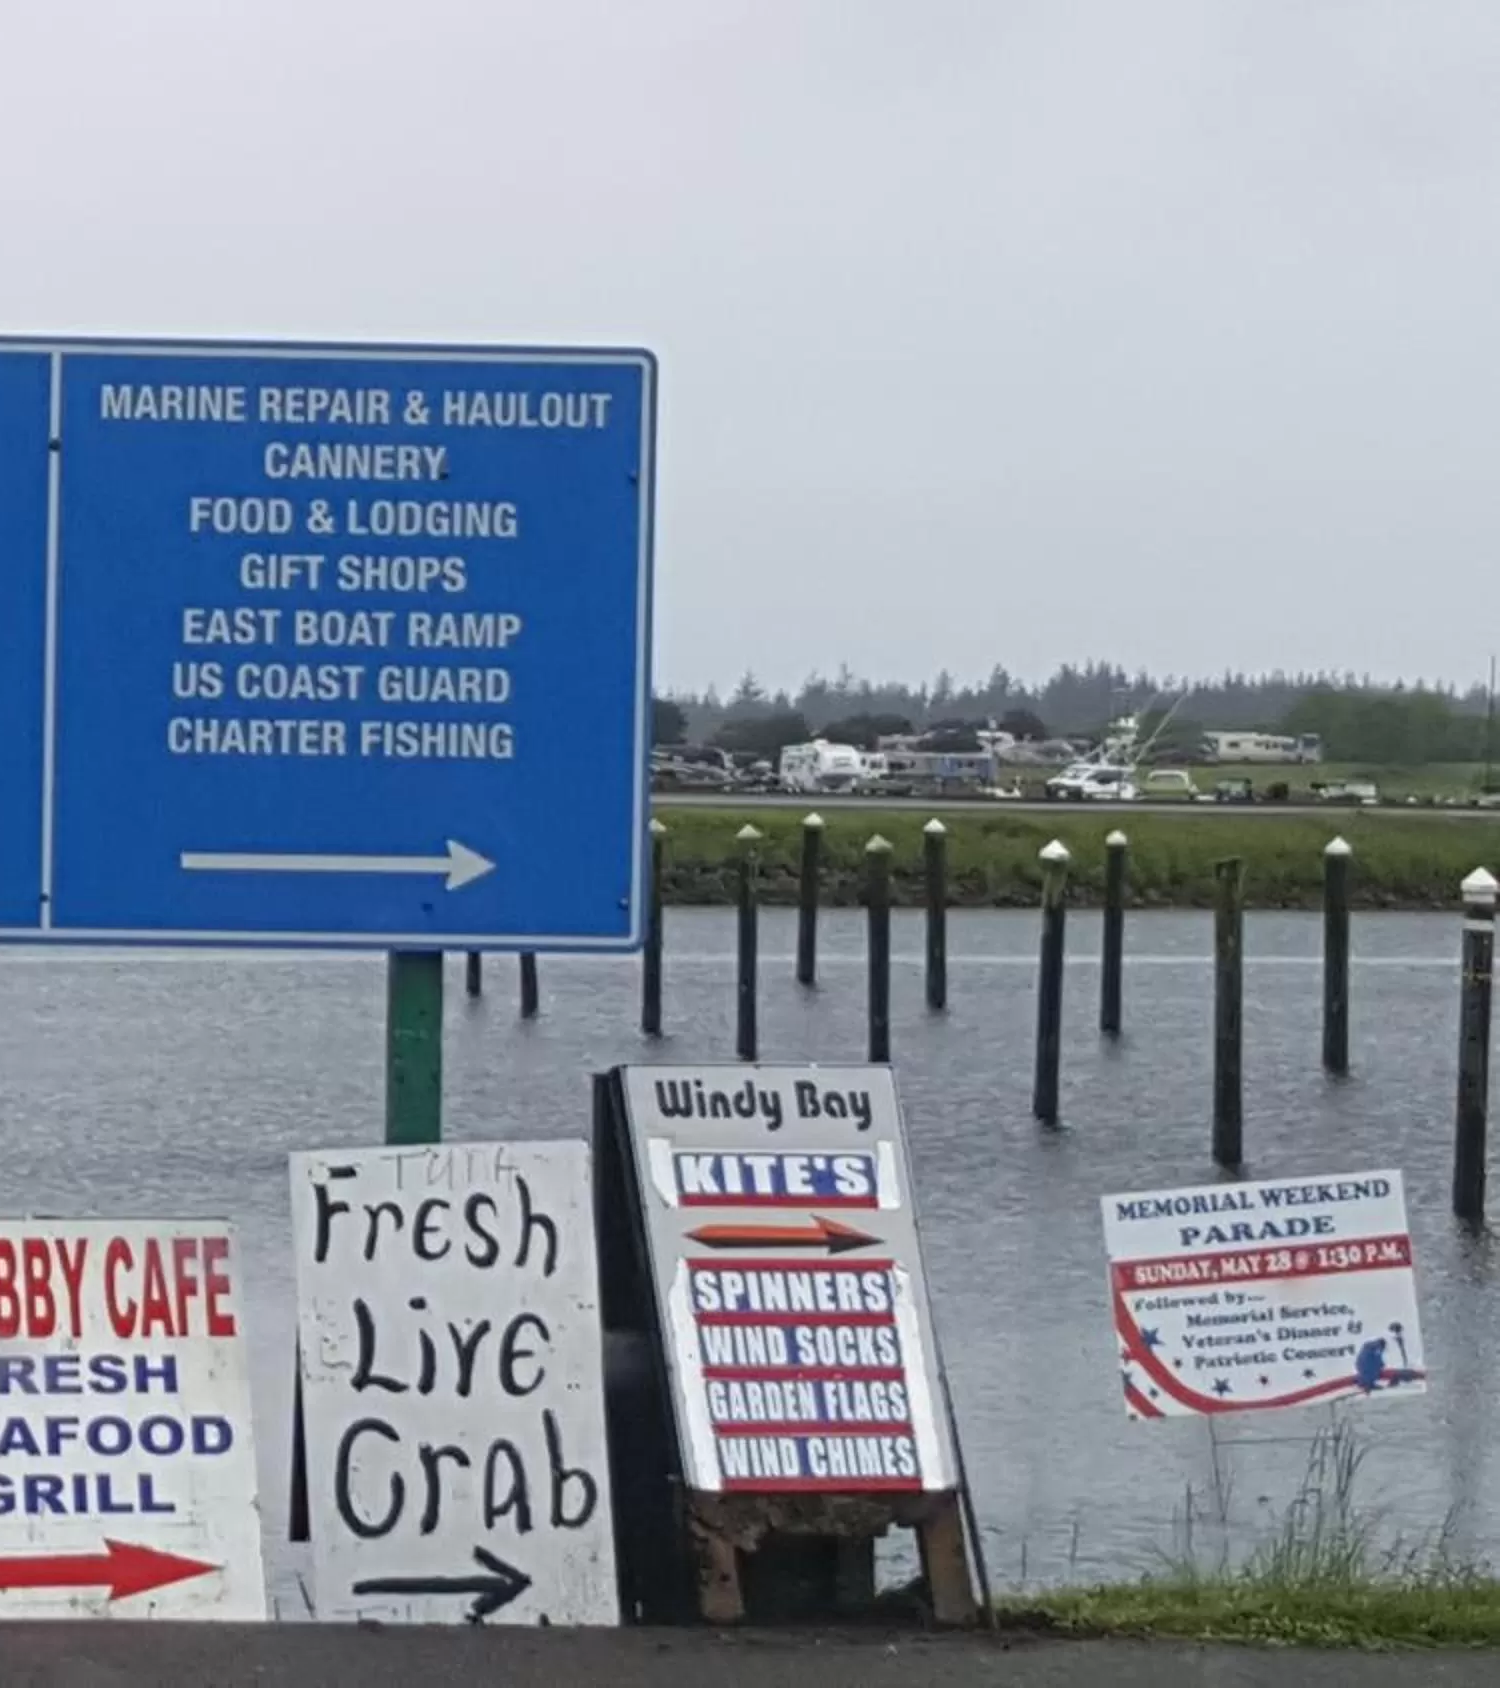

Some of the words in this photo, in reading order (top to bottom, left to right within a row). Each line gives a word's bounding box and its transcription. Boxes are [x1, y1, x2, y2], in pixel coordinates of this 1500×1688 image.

[100, 384, 247, 422] MARINE
[258, 387, 392, 424] REPAIR
[402, 391, 431, 425] &
[443, 391, 613, 429] HAULOUT
[263, 443, 447, 481] CANNERY
[189, 497, 293, 535] FOOD
[305, 500, 335, 535] &
[346, 500, 519, 538] LODGING
[239, 553, 325, 591] GIFT
[337, 556, 467, 593] SHOPS
[182, 608, 282, 646] EAST
[294, 610, 396, 646] BOAT
[407, 613, 522, 649] RAMP
[173, 662, 223, 699] US
[236, 664, 365, 701] COAST
[377, 667, 510, 703] GUARD
[167, 718, 346, 756] CHARTER
[359, 721, 514, 759] FISHING
[654, 1079, 783, 1132] Windy
[793, 1082, 872, 1132] Bay
[676, 1154, 871, 1196] KITE'S
[310, 1163, 559, 1279] Fresh
[1116, 1190, 1255, 1222] MEMORIAL
[1259, 1178, 1391, 1209] WEEKEND
[1179, 1214, 1336, 1247] PARADE
[1134, 1258, 1219, 1286] SUNDAY,
[1220, 1253, 1262, 1277] MAY
[1267, 1250, 1293, 1272] 28
[1317, 1247, 1362, 1270] 1:30
[1366, 1241, 1403, 1264] P.M.
[103, 1235, 236, 1340] CAFE
[696, 1270, 890, 1313] SPINNERS
[1133, 1292, 1219, 1313] Followed
[1182, 1329, 1273, 1350] Veteran's
[1277, 1324, 1342, 1342] Dinner
[1186, 1308, 1274, 1329] Memorial
[351, 1297, 551, 1400] Live
[702, 1325, 788, 1366] WIND
[798, 1324, 899, 1366] SOCKS
[1193, 1350, 1280, 1370] Patriotic
[1282, 1343, 1357, 1362] Concert
[708, 1379, 817, 1422] GARDEN
[825, 1378, 909, 1422] FLAGS
[334, 1407, 599, 1540] Crab
[717, 1436, 799, 1478] WIND
[806, 1435, 917, 1478] CHIMES
